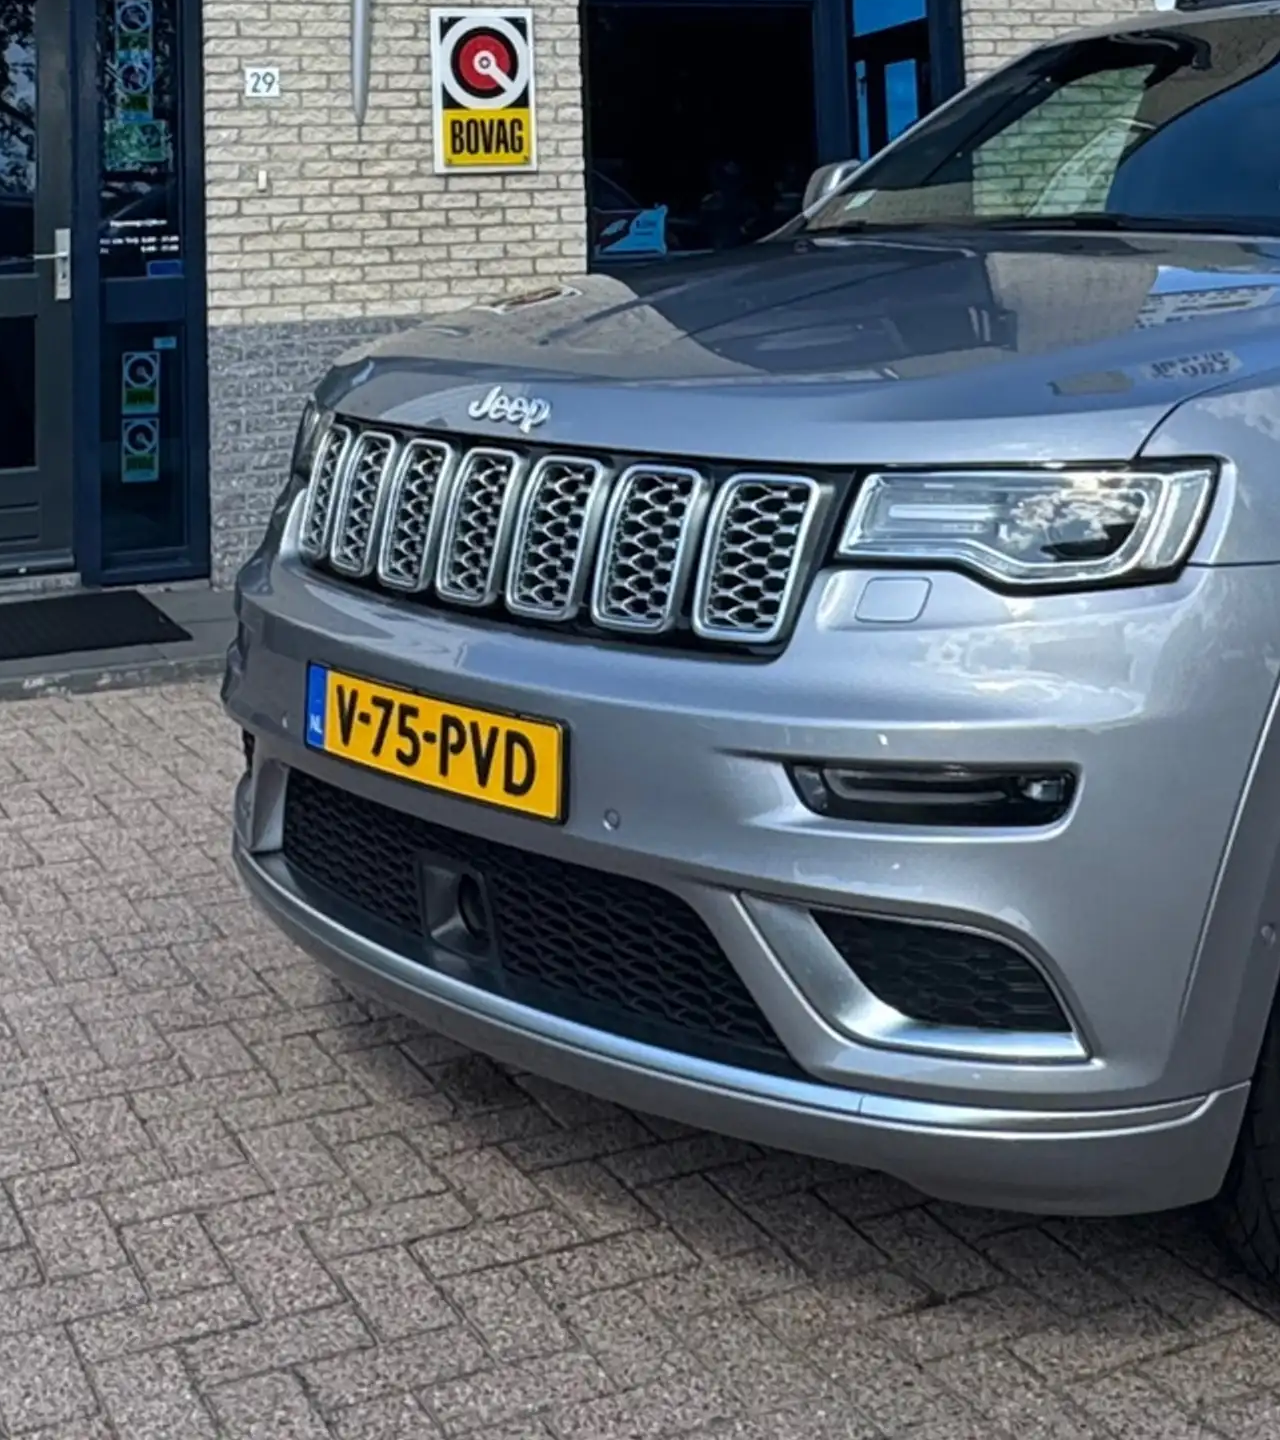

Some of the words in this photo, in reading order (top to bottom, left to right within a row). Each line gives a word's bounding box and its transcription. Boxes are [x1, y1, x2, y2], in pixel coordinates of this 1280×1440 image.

[249, 71, 276, 94] 29
[450, 118, 525, 156] BOVAG
[468, 385, 551, 434] Jeep
[309, 712, 323, 735] NL
[336, 684, 537, 797] V-75-PVD
